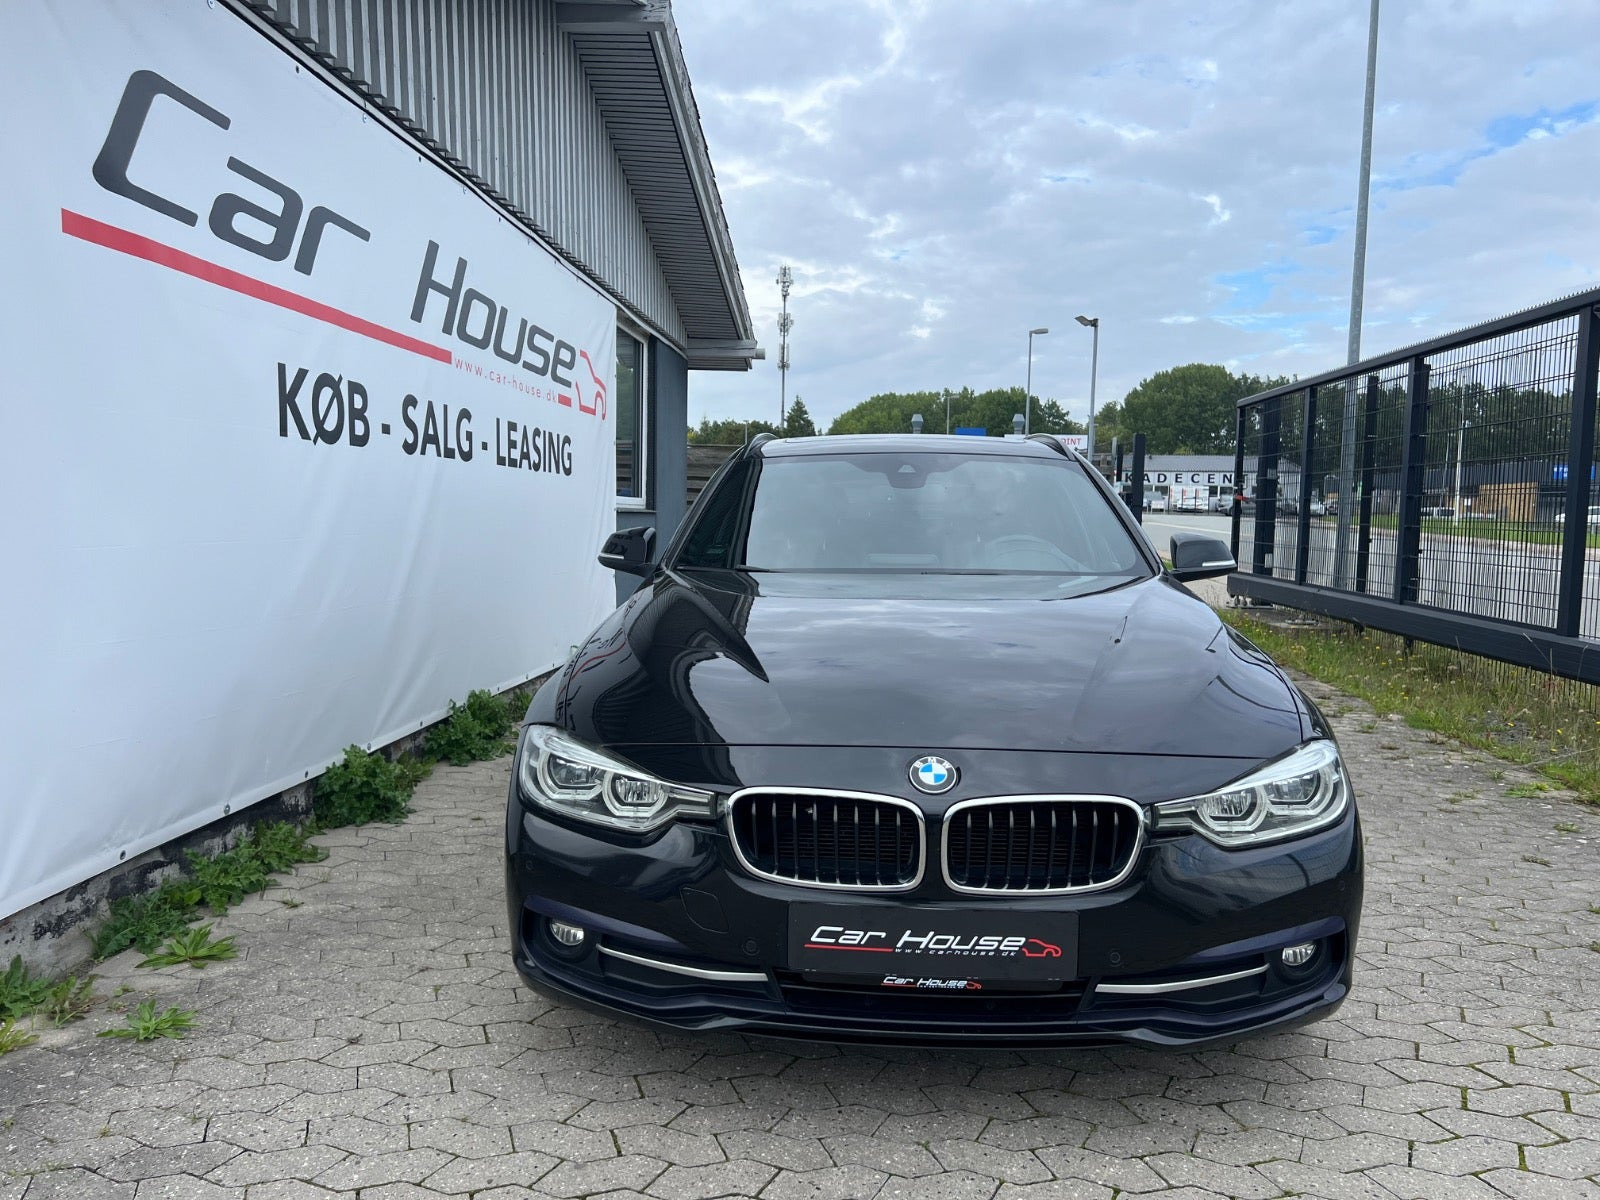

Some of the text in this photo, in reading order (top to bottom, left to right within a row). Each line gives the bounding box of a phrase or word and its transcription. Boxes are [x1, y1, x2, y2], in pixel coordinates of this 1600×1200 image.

[92, 69, 576, 389] Car House
[454, 358, 557, 403] www.car-house.dk
[277, 362, 370, 447] KØB
[401, 393, 473, 463] SALG
[496, 417, 572, 476] LEASING
[913, 757, 953, 769] BMW
[811, 926, 1026, 951] Car House
[895, 948, 1017, 957] www.carhouse.dk
[883, 976, 914, 985] Car
[917, 977, 968, 989] House
